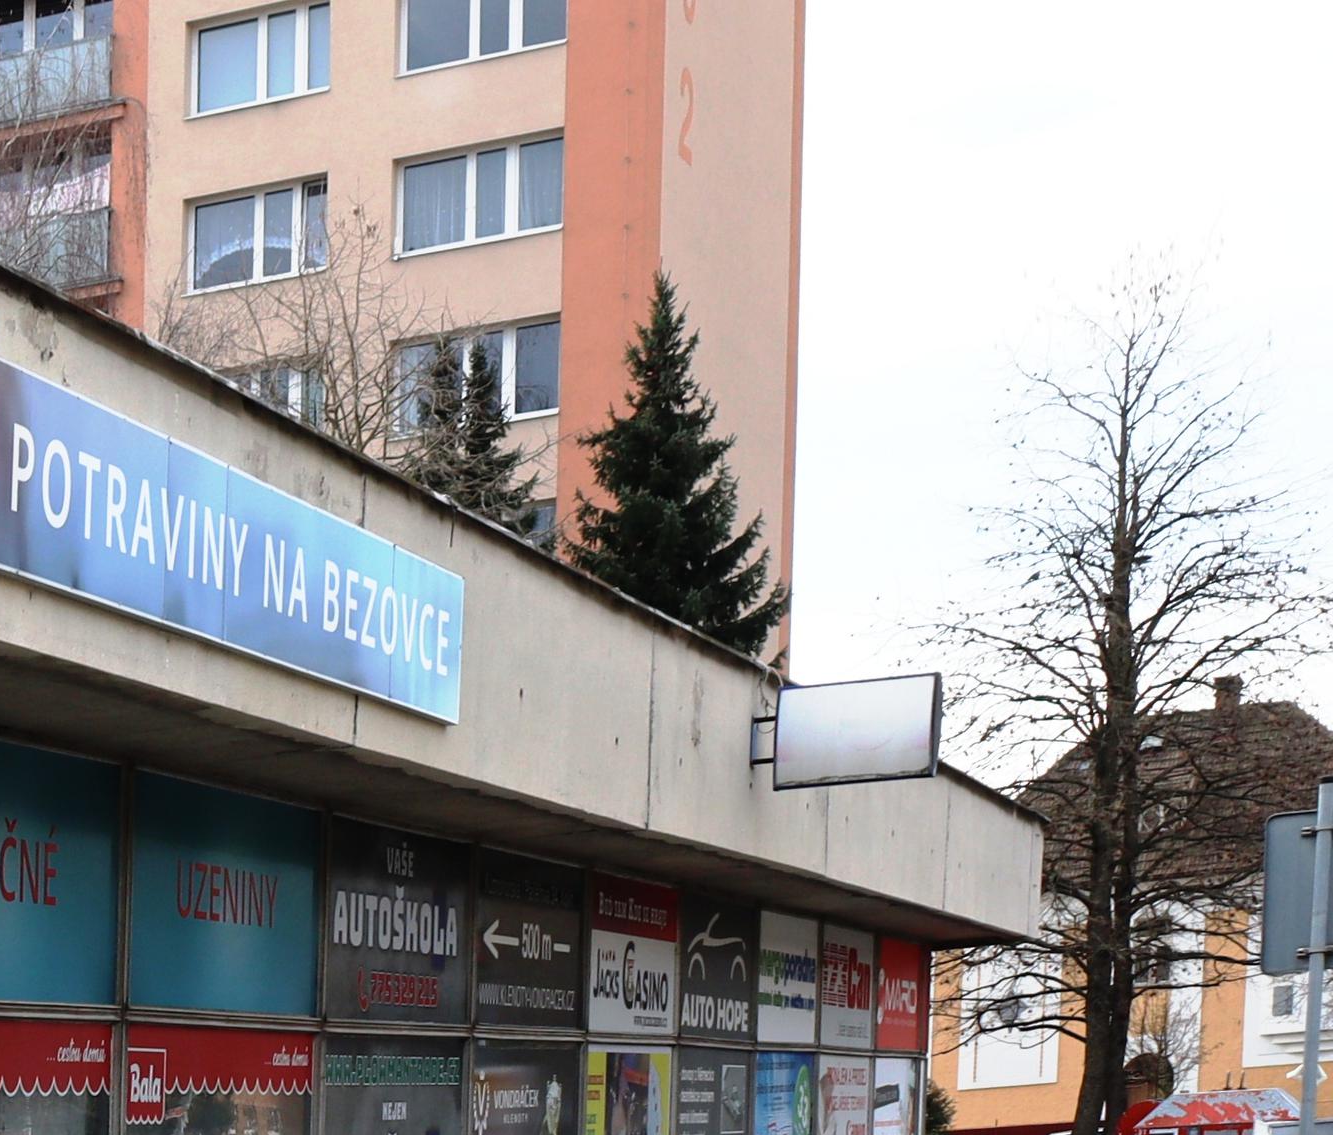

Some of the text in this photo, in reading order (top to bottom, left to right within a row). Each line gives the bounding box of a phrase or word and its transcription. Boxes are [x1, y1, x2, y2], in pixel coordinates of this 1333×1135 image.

[10, 422, 450, 677] POTRAVINY NA BEZOVCE
[387, 842, 414, 878] VAŠE
[177, 857, 278, 928] UZENINY
[333, 885, 457, 957] AUTOŠKOLA
[521, 922, 552, 961] 500 m
[623, 941, 669, 1013] CASINO
[681, 993, 715, 1029] AUTO
[716, 998, 749, 1032] HOPE
[57, 1038, 105, 1063] cestou domů
[130, 1063, 162, 1103] Bala
[493, 1085, 539, 1110] VONDRÁČEK
